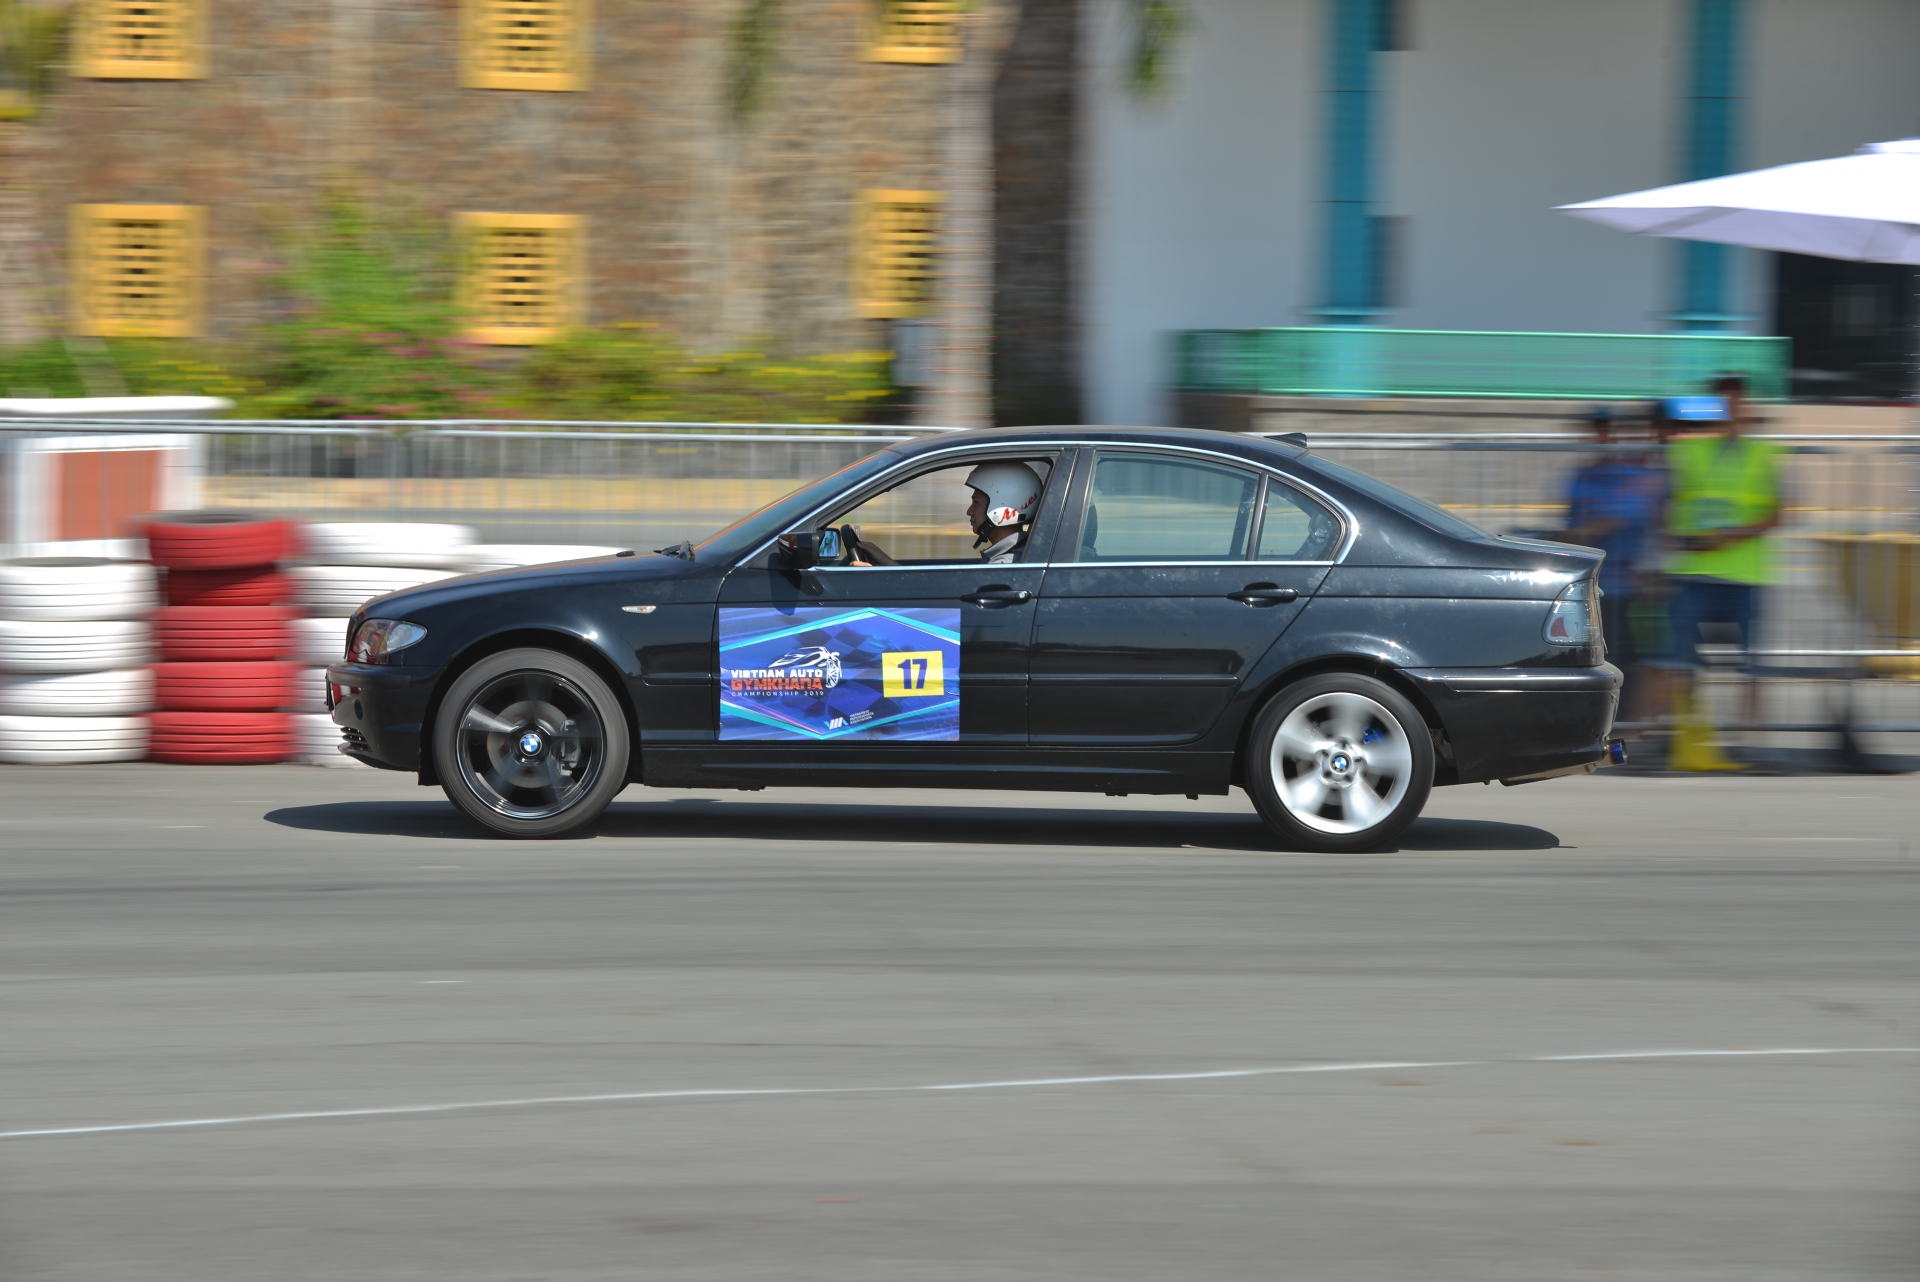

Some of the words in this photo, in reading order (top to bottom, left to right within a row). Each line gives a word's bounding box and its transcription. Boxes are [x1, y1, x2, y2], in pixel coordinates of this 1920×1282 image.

[730, 669, 785, 679] VIETNAM
[790, 669, 823, 678] AUTO
[897, 658, 928, 690] 17
[731, 678, 823, 690] GYMKHANA
